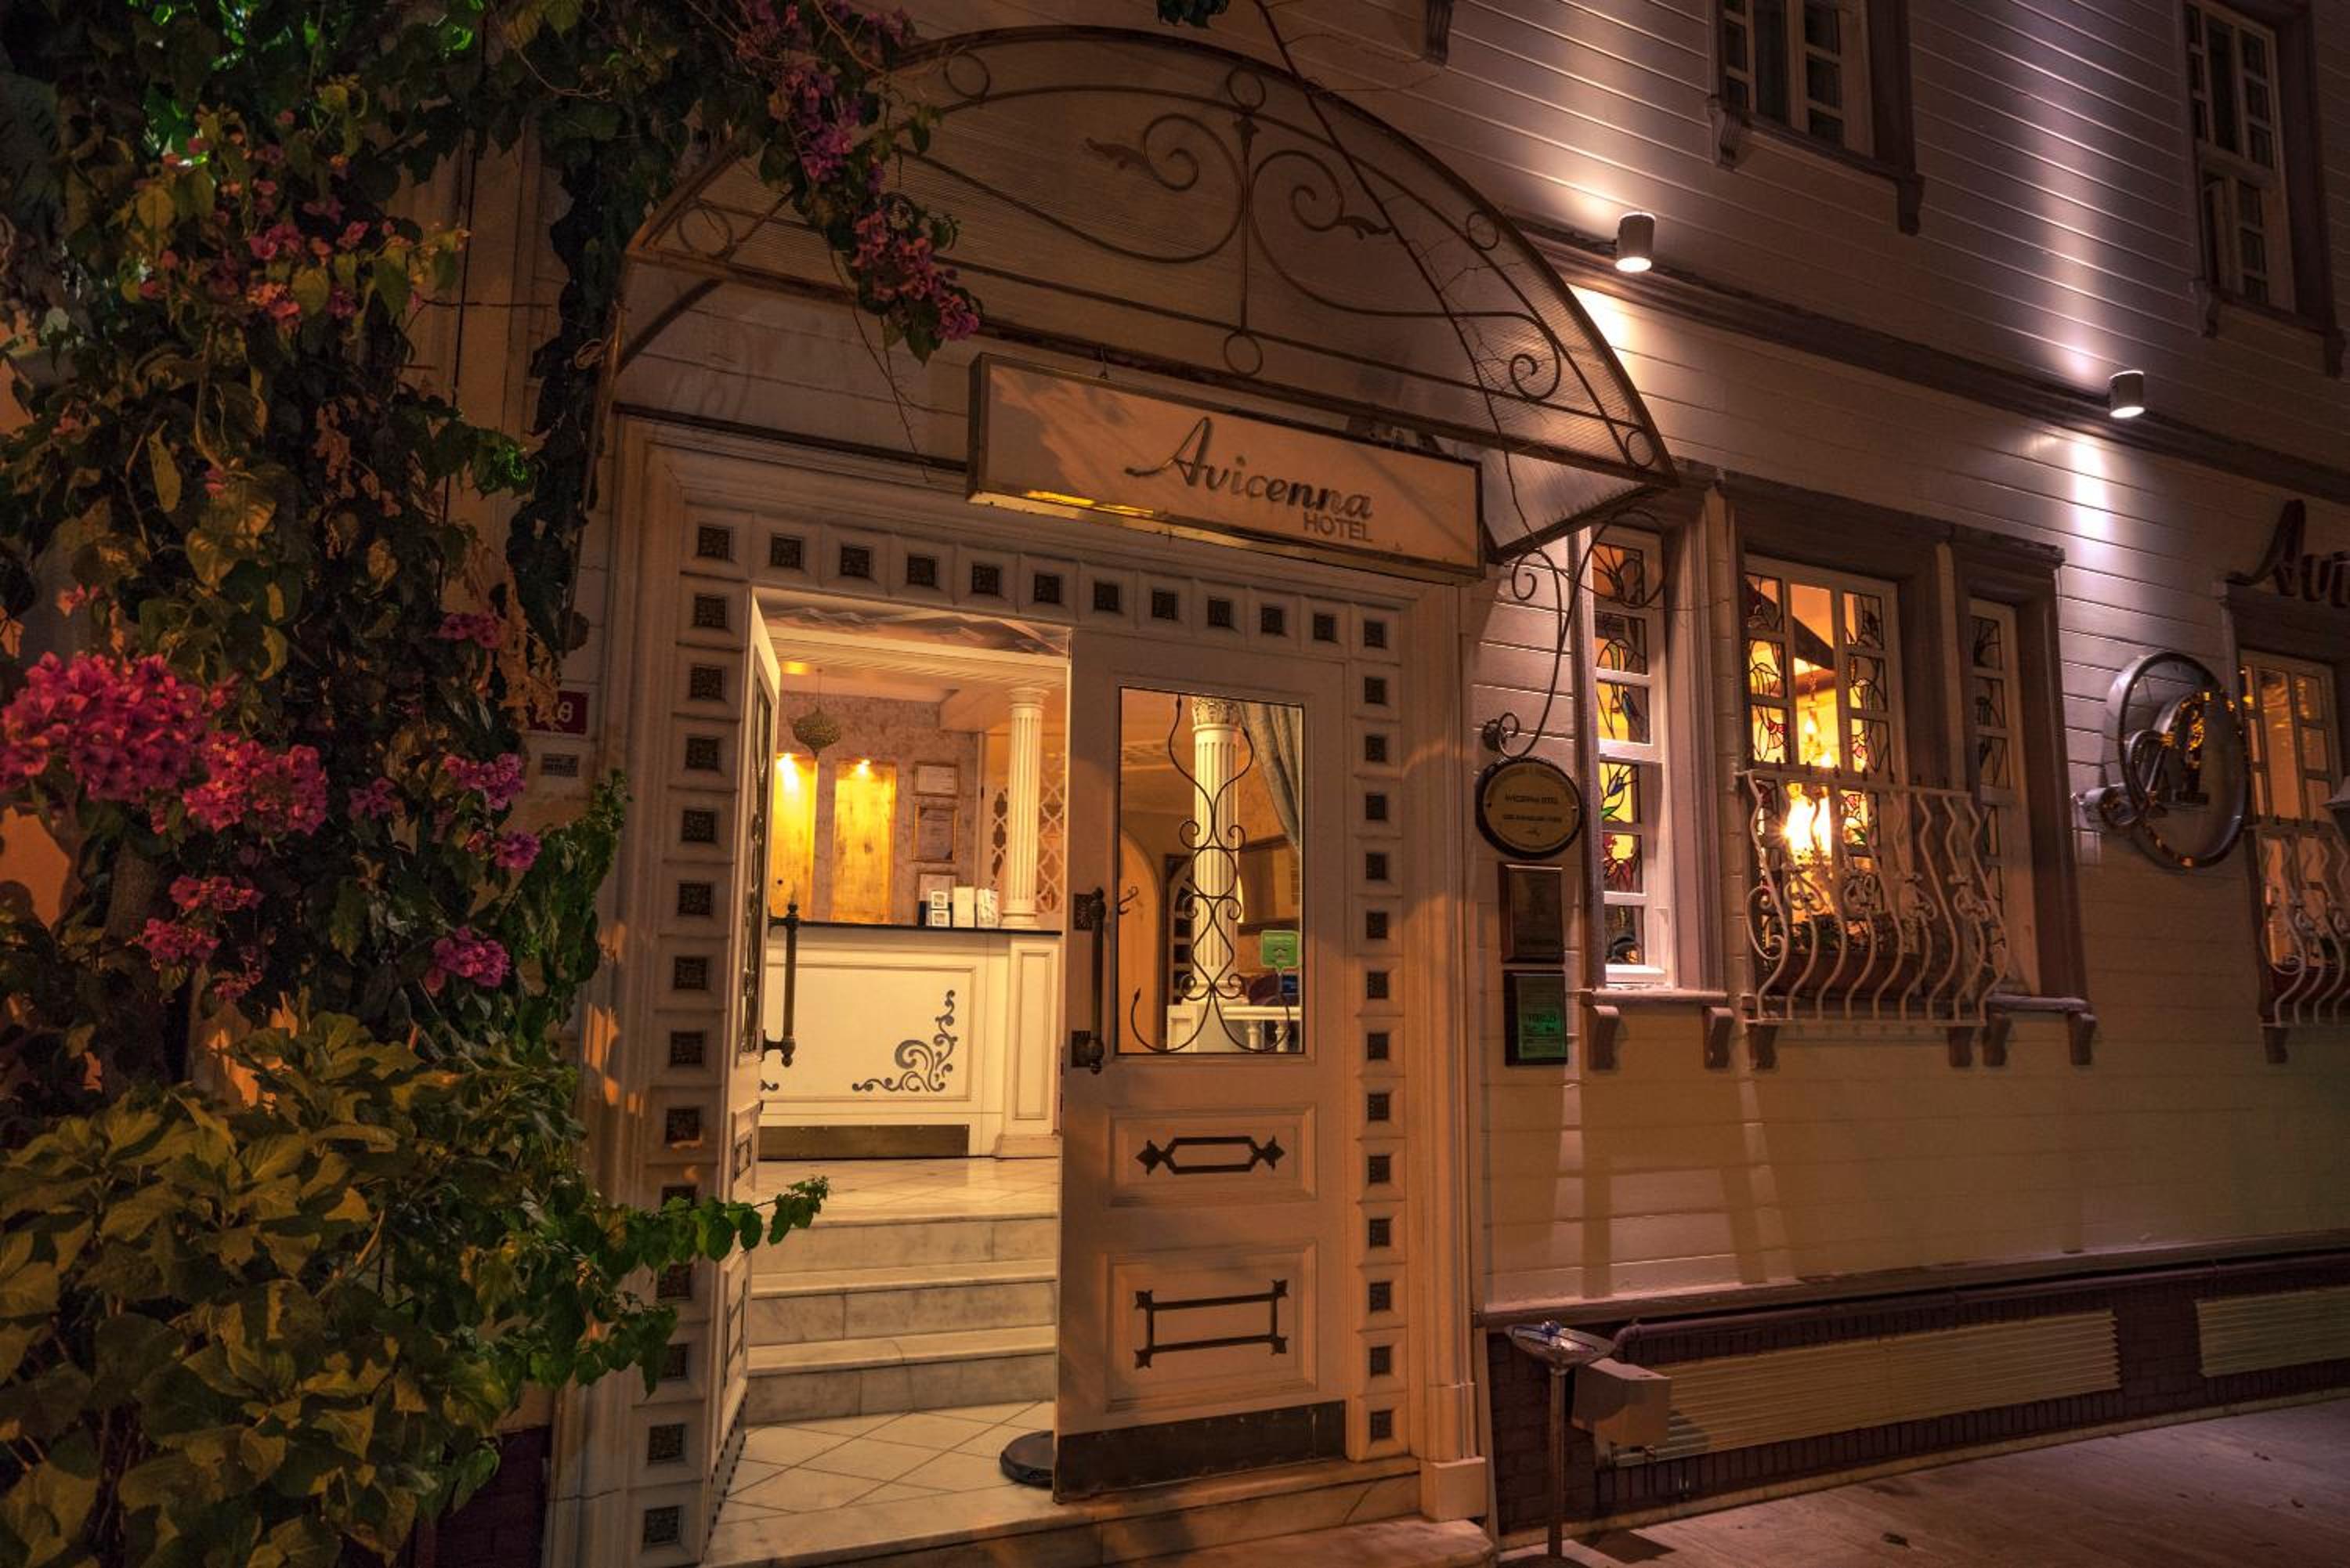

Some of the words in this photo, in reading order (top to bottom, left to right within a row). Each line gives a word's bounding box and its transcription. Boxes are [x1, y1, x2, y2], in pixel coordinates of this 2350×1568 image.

[1125, 417, 1372, 518] Avicenna
[1304, 514, 1373, 541] HOTEL
[2225, 499, 2350, 608] Avi
